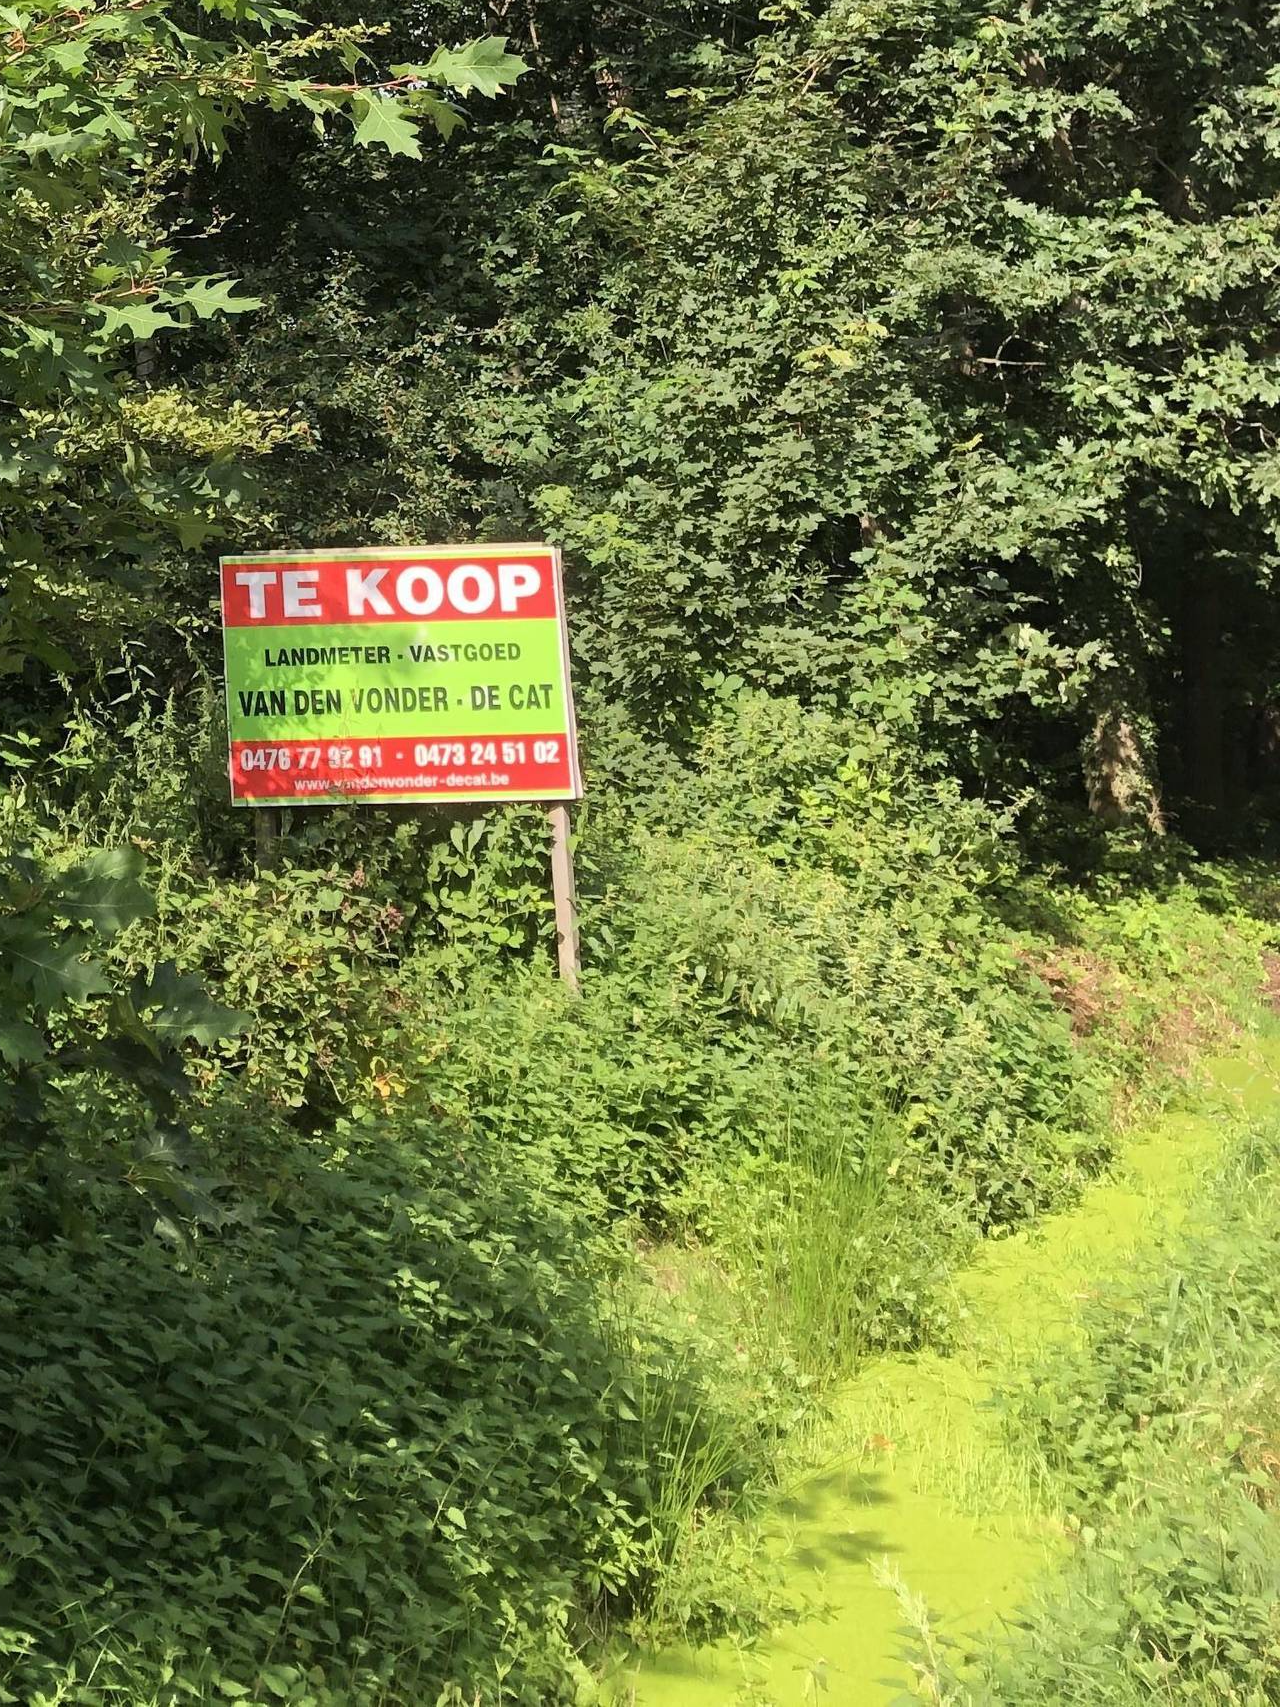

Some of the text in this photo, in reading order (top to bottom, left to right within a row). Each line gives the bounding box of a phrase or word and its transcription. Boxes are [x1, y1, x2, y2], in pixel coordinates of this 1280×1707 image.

[235, 563, 542, 619] TE KOOP
[265, 646, 391, 667] LANDMETER
[409, 643, 521, 663] VASTGOED
[238, 691, 286, 717] VAN
[294, 690, 342, 715] DEN
[352, 687, 449, 713] VONDER
[471, 686, 502, 711] DE
[508, 684, 554, 710] CAT
[240, 748, 291, 771] 0476
[296, 747, 321, 769] 77
[359, 745, 383, 768] 91
[414, 744, 466, 767] 0473
[470, 742, 497, 765] 24
[502, 741, 526, 765] 51
[533, 740, 561, 764] 02
[294, 772, 510, 791] wwwvndenvonder-decat.be
